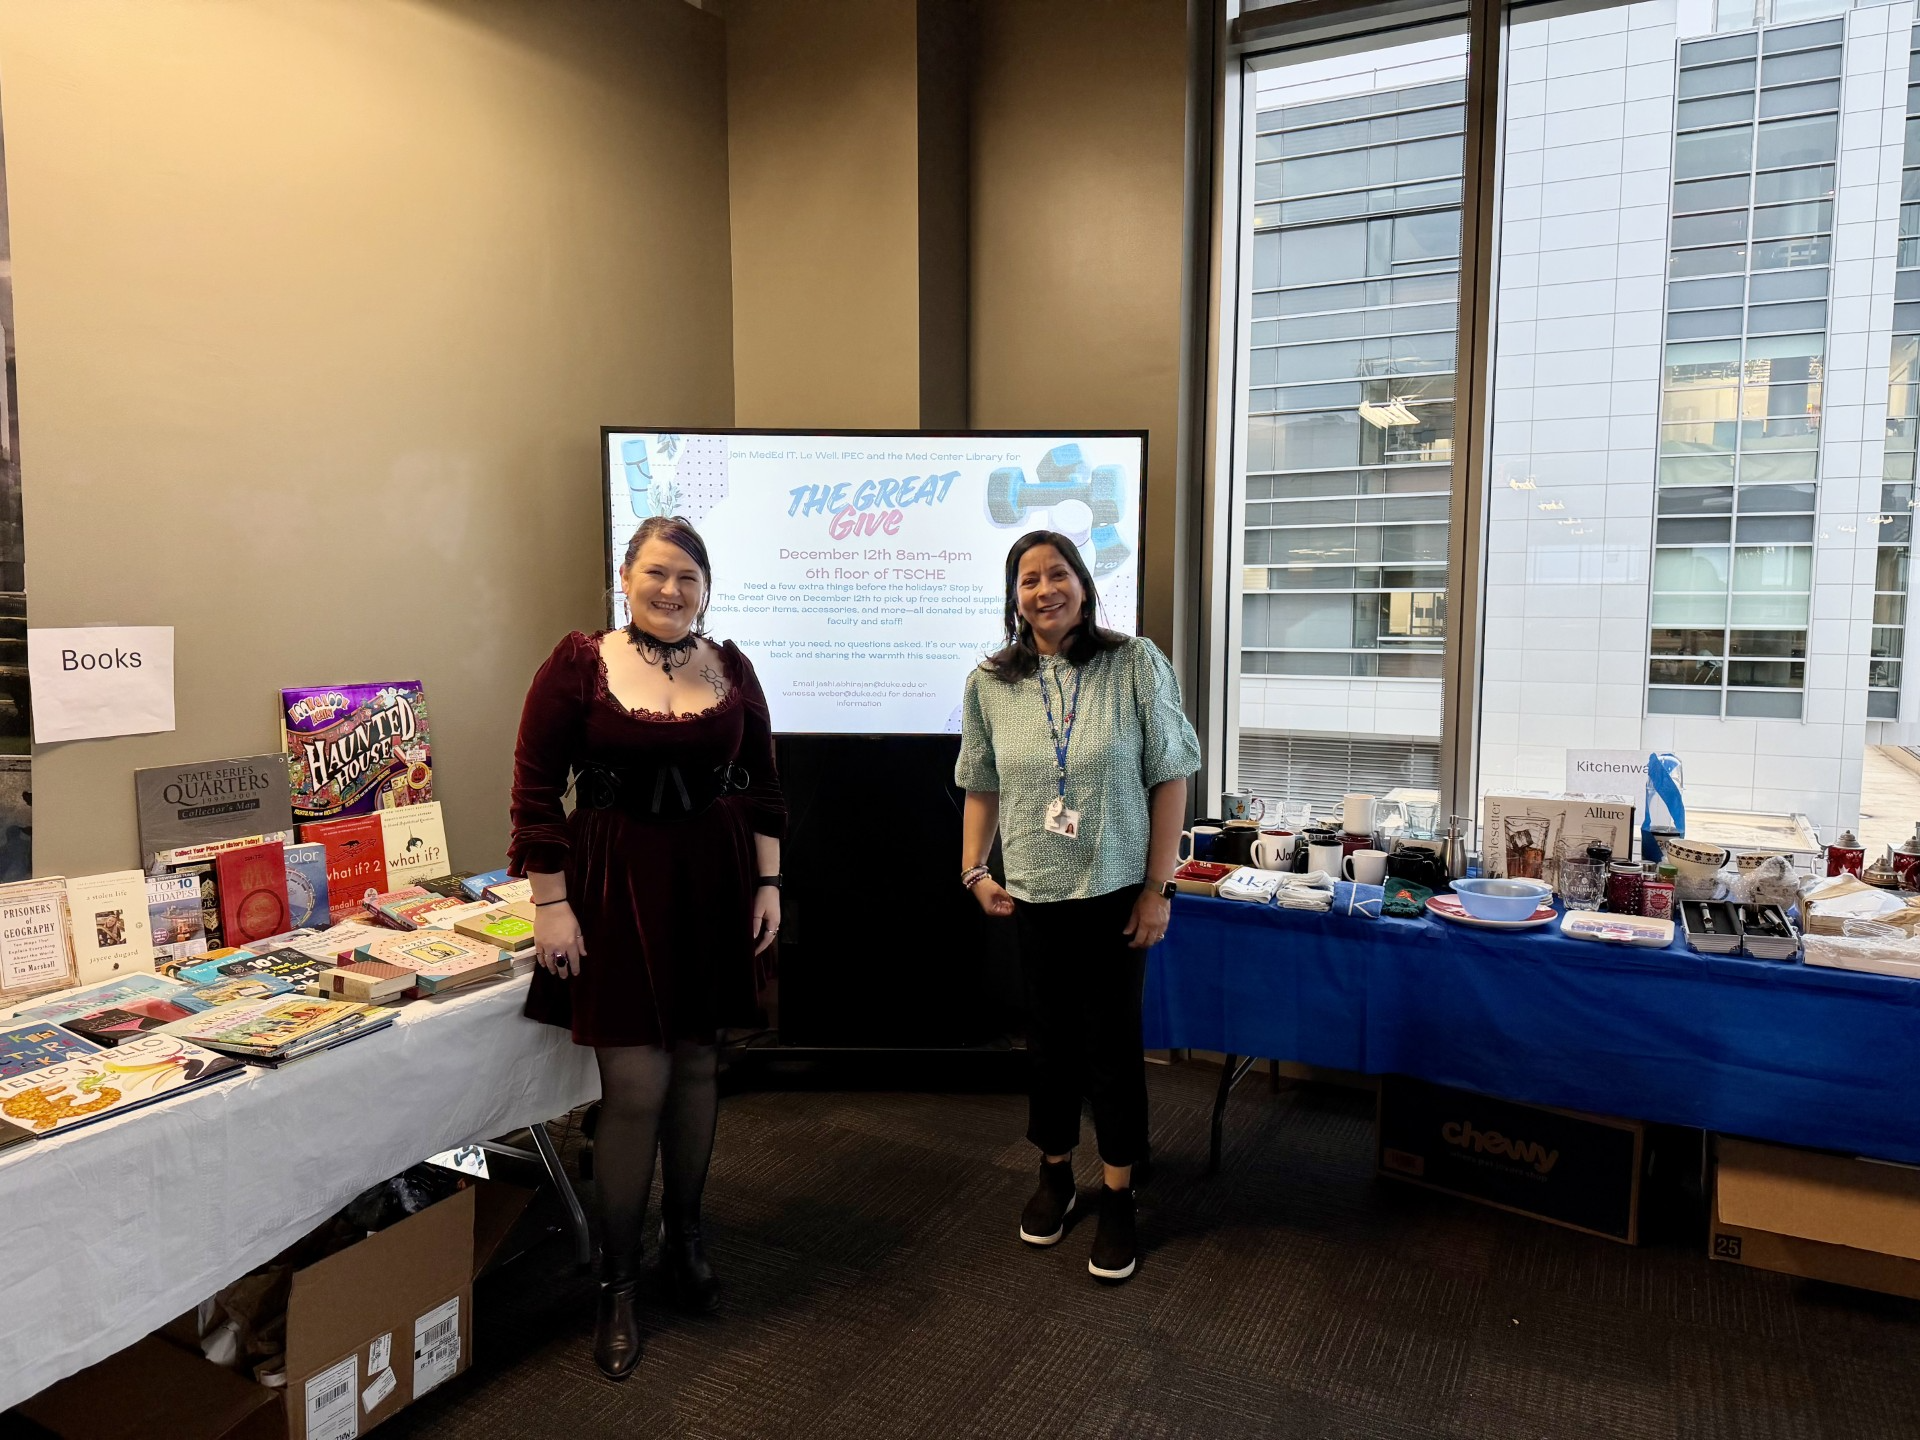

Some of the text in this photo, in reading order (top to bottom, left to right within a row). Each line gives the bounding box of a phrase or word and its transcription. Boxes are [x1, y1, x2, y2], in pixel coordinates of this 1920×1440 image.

[728, 450, 746, 460] Join
[750, 450, 784, 460] MedEd
[842, 452, 864, 460] IPEC
[866, 452, 884, 460] and
[888, 452, 904, 460] the
[905, 452, 928, 460] Med
[930, 452, 964, 461] Center
[966, 452, 1003, 462] Library
[1006, 452, 1022, 460] for
[788, 470, 962, 518] THE GREAT
[780, 548, 860, 560] December
[864, 548, 892, 560] 12th
[806, 568, 946, 580] 6th floor of TSCHE
[744, 582, 768, 590] Need
[778, 582, 796, 590] few
[798, 582, 824, 591] extra
[826, 582, 854, 592] things
[856, 582, 887, 592] before
[888, 582, 904, 592] the
[905, 583, 948, 592] holidays?
[949, 584, 970, 592] Stop
[972, 584, 984, 593] by
[716, 594, 736, 602] The
[738, 594, 764, 602] Great
[766, 594, 788, 602] Give
[802, 594, 852, 602] December
[853, 594, 871, 602] 12th
[884, 595, 902, 604] pick
[906, 596, 918, 604] up
[942, 596, 971, 604] school
[861, 606, 880, 614] and
[926, 607, 961, 615] donated
[964, 608, 976, 616] by
[827, 618, 859, 626] faculty
[860, 618, 878, 626] and
[740, 640, 760, 648] take
[762, 640, 786, 648] what
[847, 640, 891, 650] questions
[892, 640, 923, 649] asked.
[925, 640, 938, 649] It's
[959, 642, 978, 650] way
[980, 640, 990, 649] of
[60, 648, 142, 670] Books
[770, 650, 961, 660] back and sharing the warmth this season.
[792, 680, 815, 688] Email
[888, 690, 901, 698] for
[902, 690, 937, 698] donation
[302, 694, 416, 794] HAUNTED
[334, 738, 392, 792] HOUSE
[1576, 760, 1650, 774] Kitchenwa
[176, 766, 254, 784] STATE SERIES
[163, 772, 270, 806] QUARTERS
[181, 801, 256, 818] Collector's Map
[1584, 806, 1624, 820] Allure
[174, 849, 192, 857] Collect
[193, 846, 205, 854] Your
[226, 841, 244, 849] History
[244, 838, 260, 846] Today!
[388, 846, 440, 868] what if?
[354, 862, 370, 876] if?
[373, 860, 382, 872] 2
[152, 878, 193, 892] TOP 10
[92, 892, 114, 901] stolen
[148, 888, 200, 904] BUDAPEST
[4, 904, 52, 919] PRISONERS
[330, 900, 355, 912] andall
[25, 916, 32, 925] of
[4, 922, 56, 939] GEOGRAPHY
[89, 949, 139, 964] jaycee dugard
[246, 955, 283, 970] 101
[14, 960, 56, 974] Tim Marshall
[78, 1038, 164, 1066] HELLO
[1442, 1120, 1560, 1174] chewy
[1716, 1238, 1738, 1256] 25
